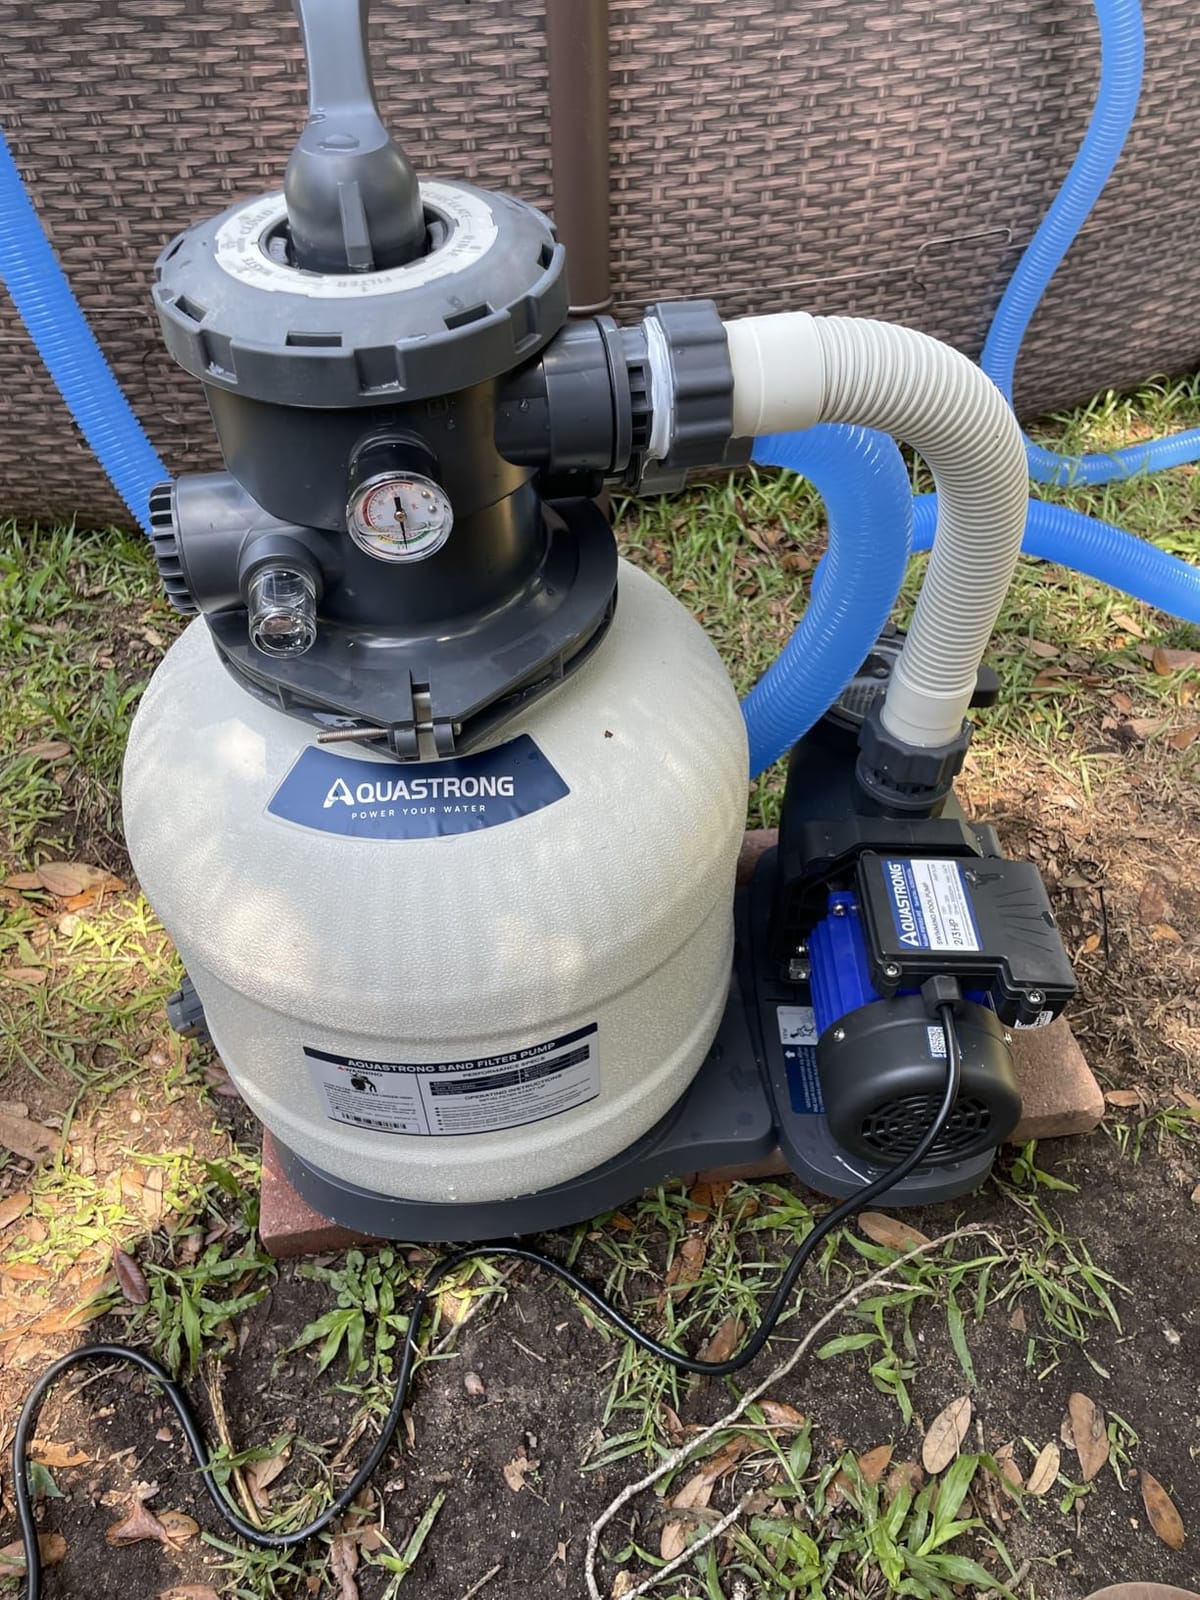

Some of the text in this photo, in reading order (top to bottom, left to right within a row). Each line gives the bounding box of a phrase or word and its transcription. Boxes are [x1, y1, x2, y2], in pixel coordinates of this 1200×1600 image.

[322, 775, 515, 809] AQUASTRONG
[351, 804, 487, 820] POWER YOUR WATER
[889, 863, 920, 947] AQUASTRONG
[347, 1041, 556, 1073] AQUASTRONG SAND FILTER PUMP
